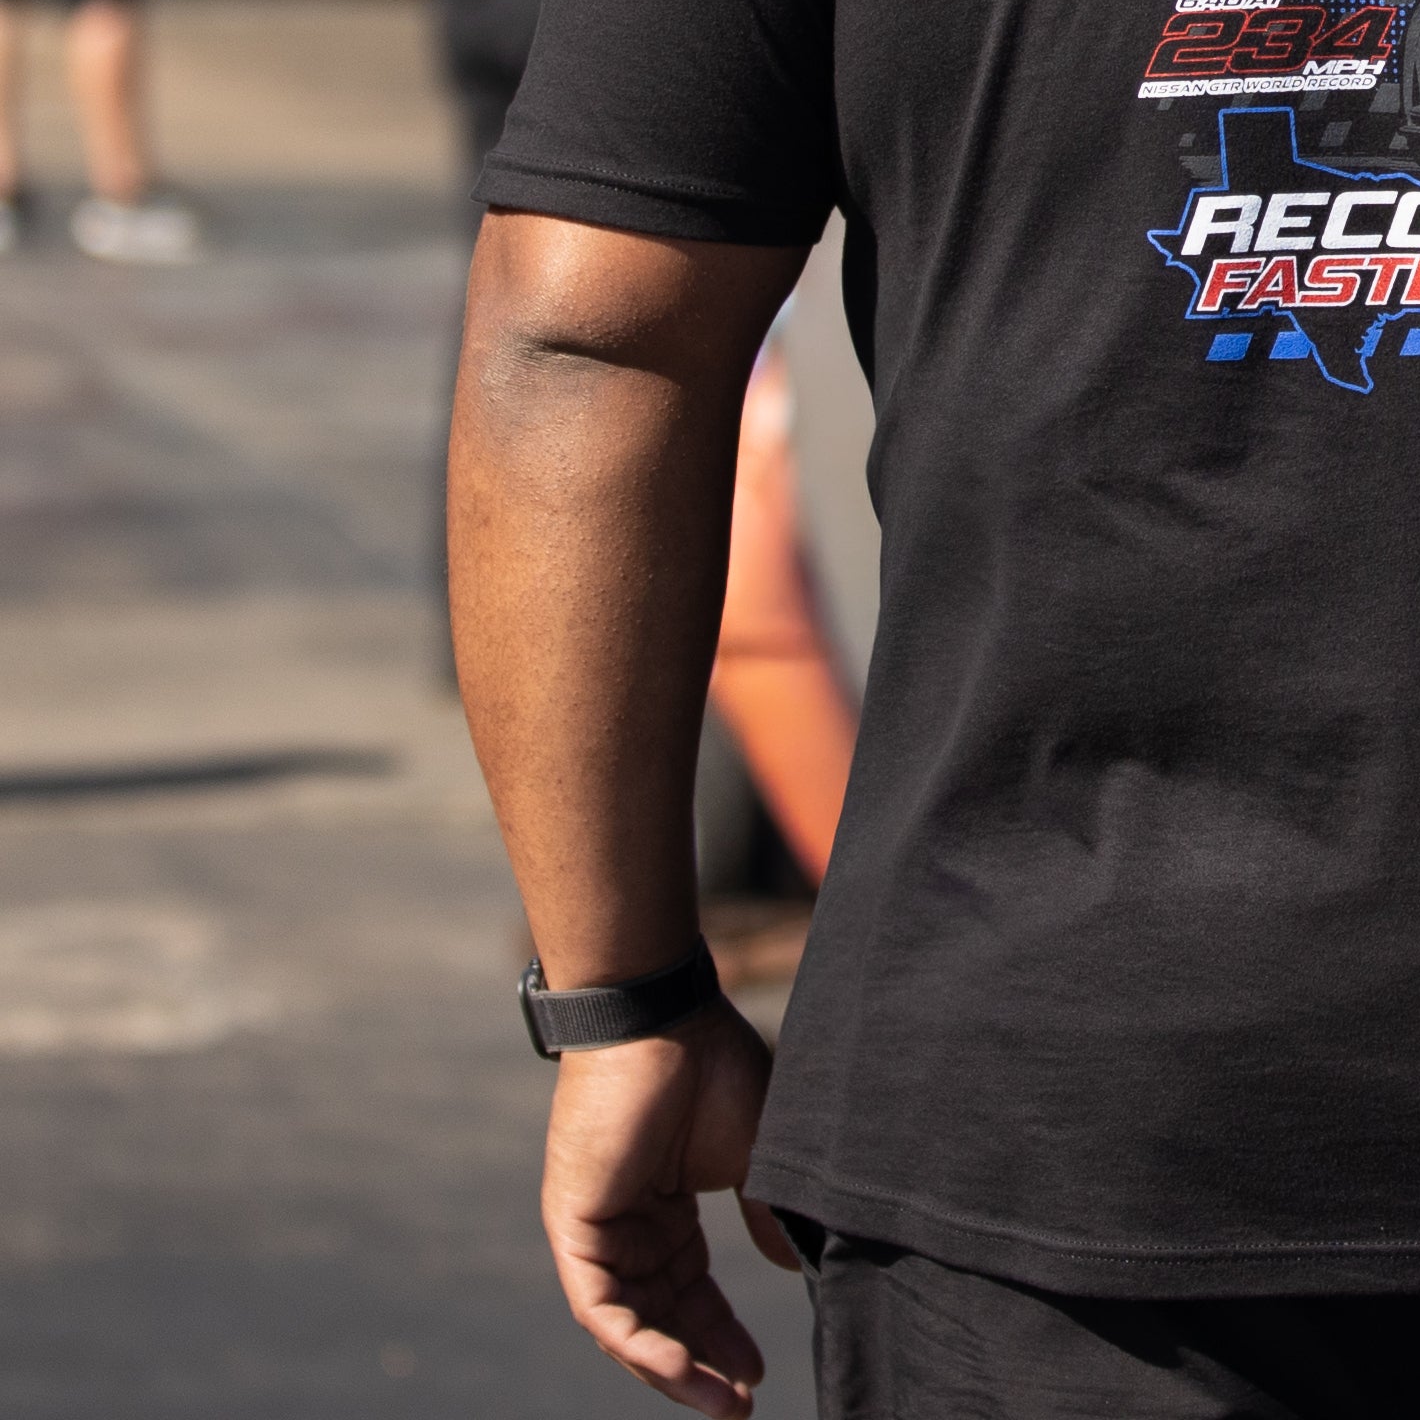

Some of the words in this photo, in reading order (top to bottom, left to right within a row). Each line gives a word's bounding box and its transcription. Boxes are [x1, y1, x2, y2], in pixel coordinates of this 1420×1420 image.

[1145, 5, 1398, 77] 234
[1303, 60, 1386, 74] MPH
[1142, 81, 1205, 96] NISSAN
[1209, 80, 1242, 94] GTR
[1246, 78, 1303, 92] WORLD
[1306, 75, 1375, 89] RECORD
